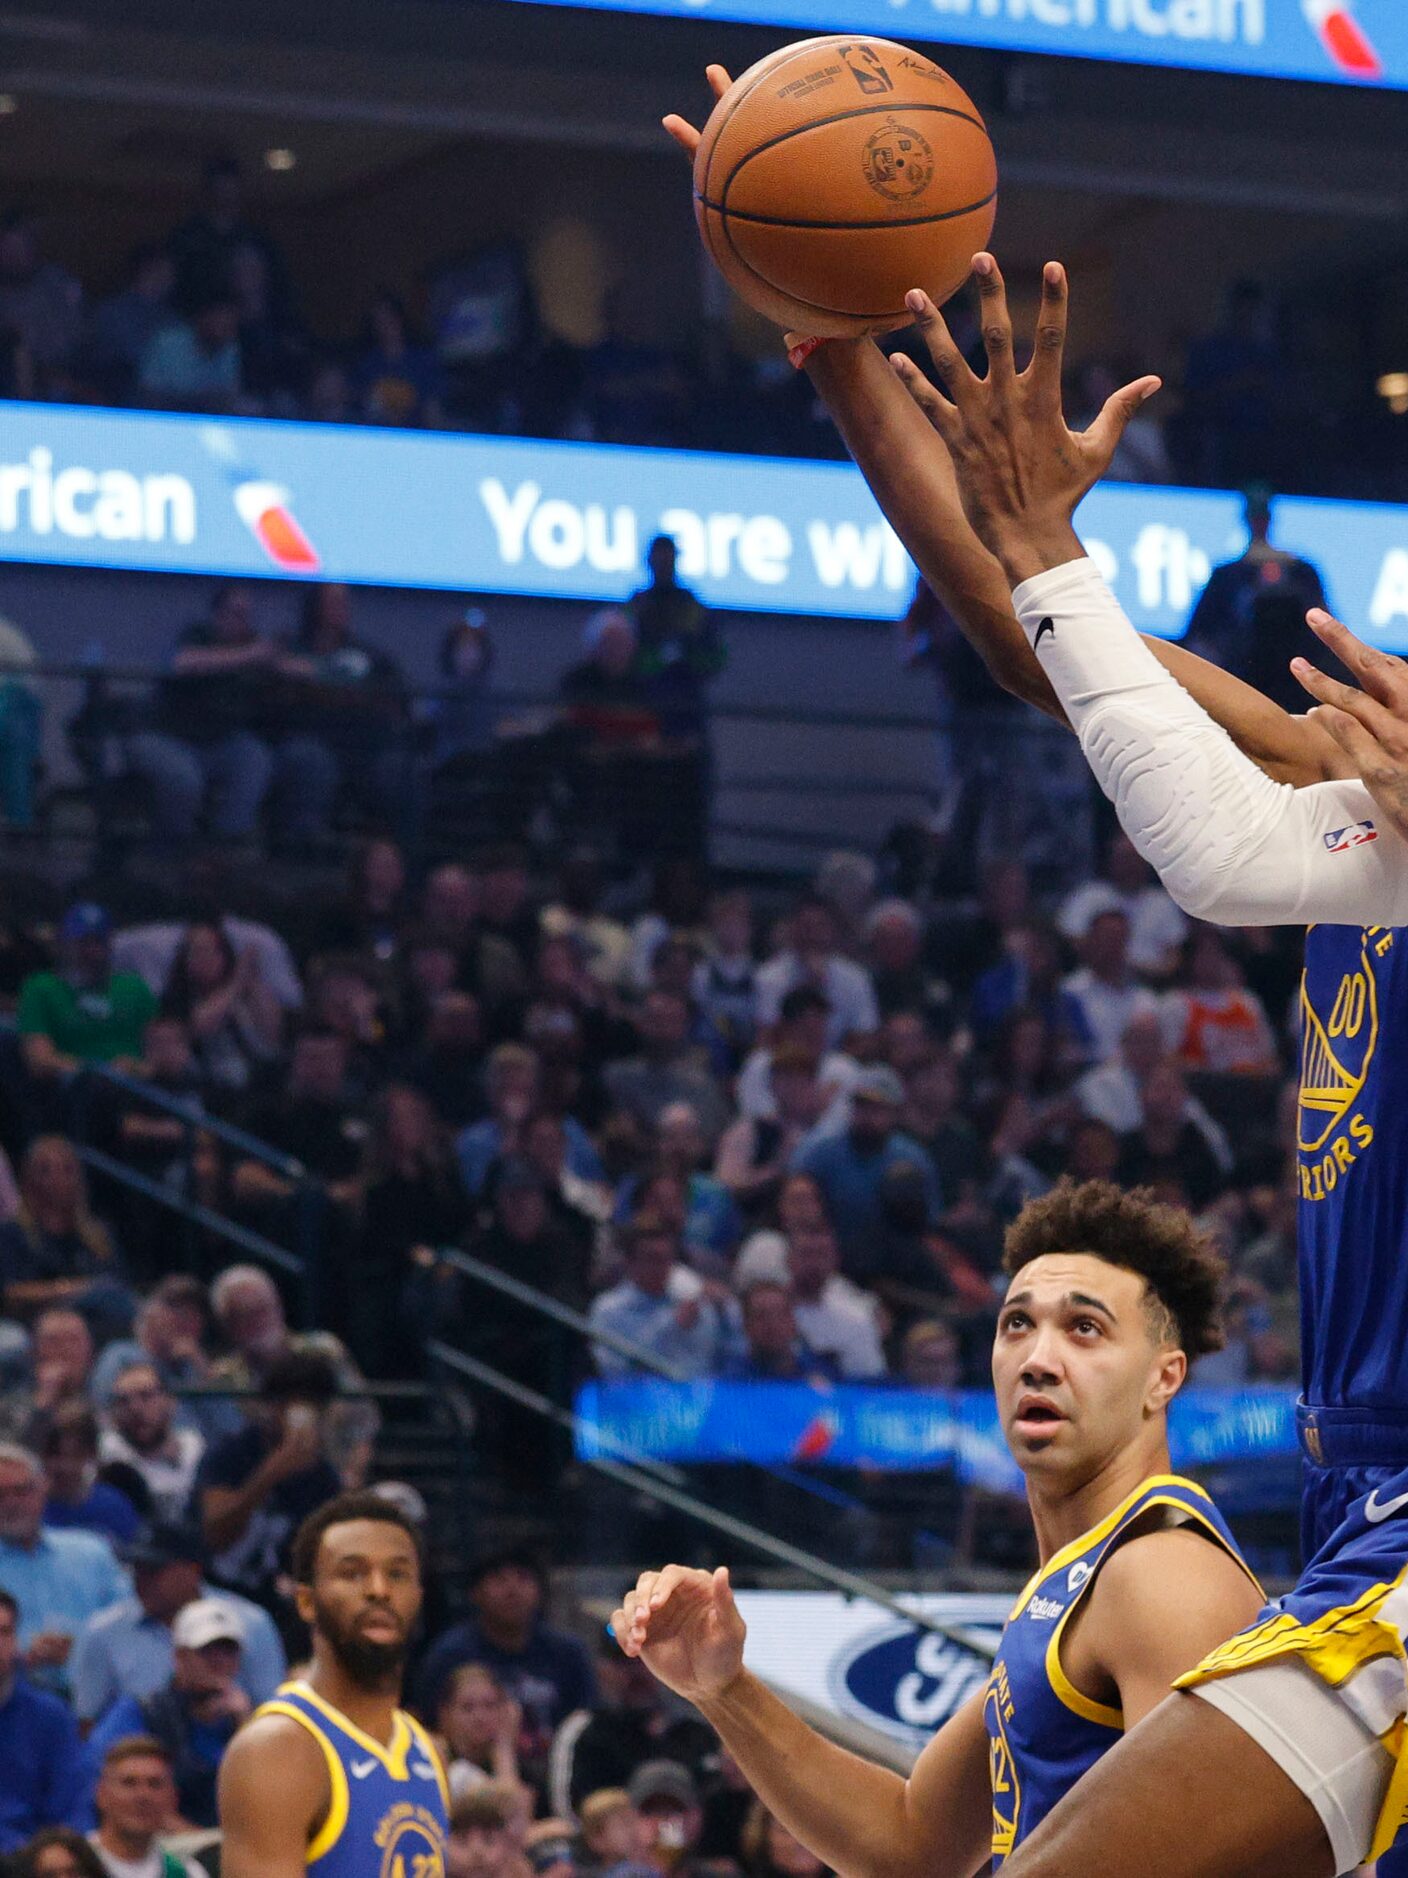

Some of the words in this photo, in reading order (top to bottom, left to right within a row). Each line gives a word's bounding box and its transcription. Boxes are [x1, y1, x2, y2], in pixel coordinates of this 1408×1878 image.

[480, 476, 637, 573] You
[659, 508, 794, 584] are
[1327, 971, 1367, 1039] 00
